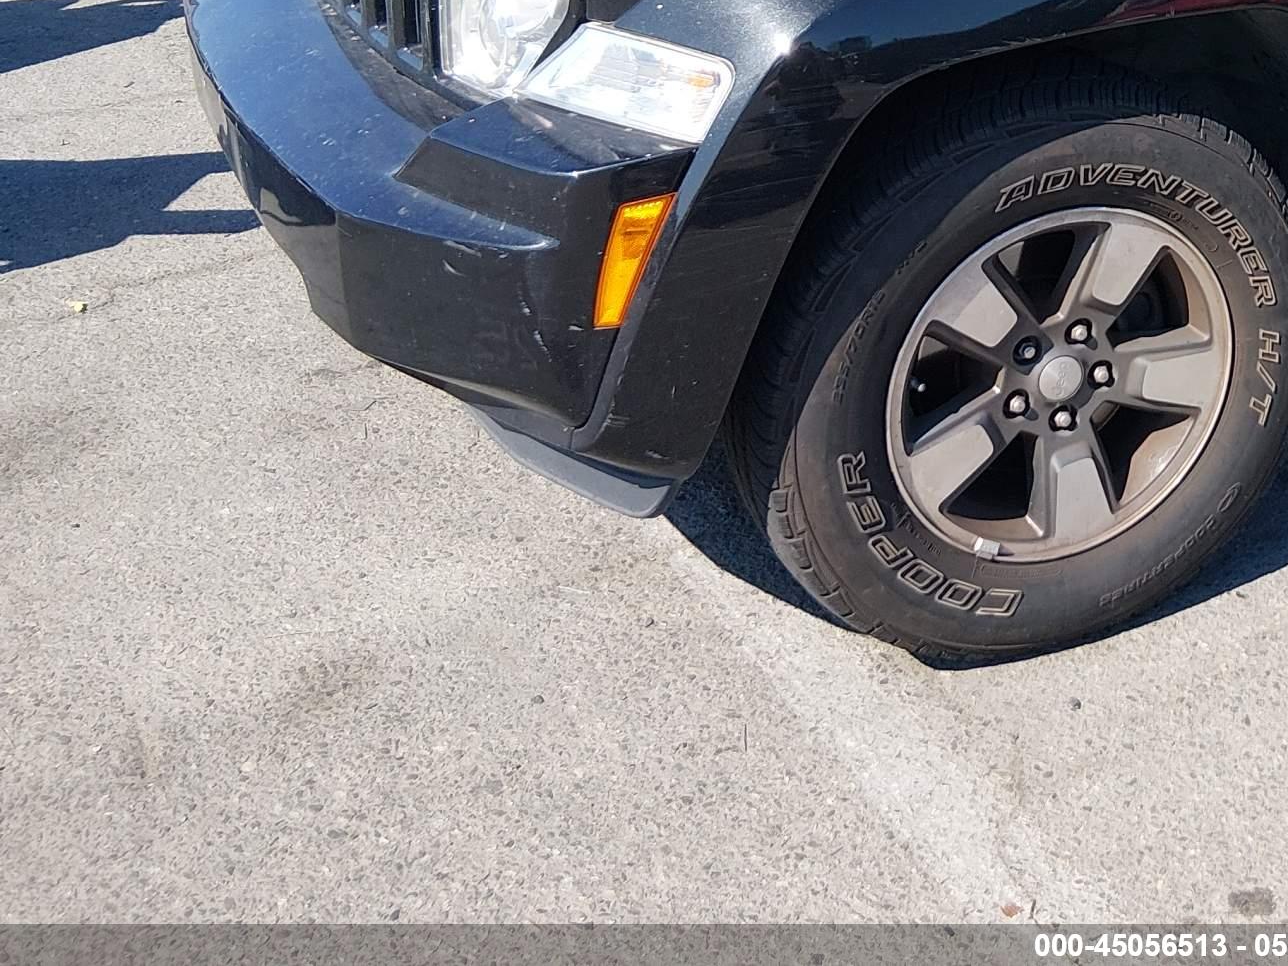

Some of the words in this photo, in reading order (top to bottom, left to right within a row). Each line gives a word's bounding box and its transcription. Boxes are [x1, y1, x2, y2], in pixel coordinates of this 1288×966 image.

[994, 162, 1280, 308] ADVENTURER
[1249, 331, 1282, 427] H/T
[837, 453, 1024, 617] COOPER
